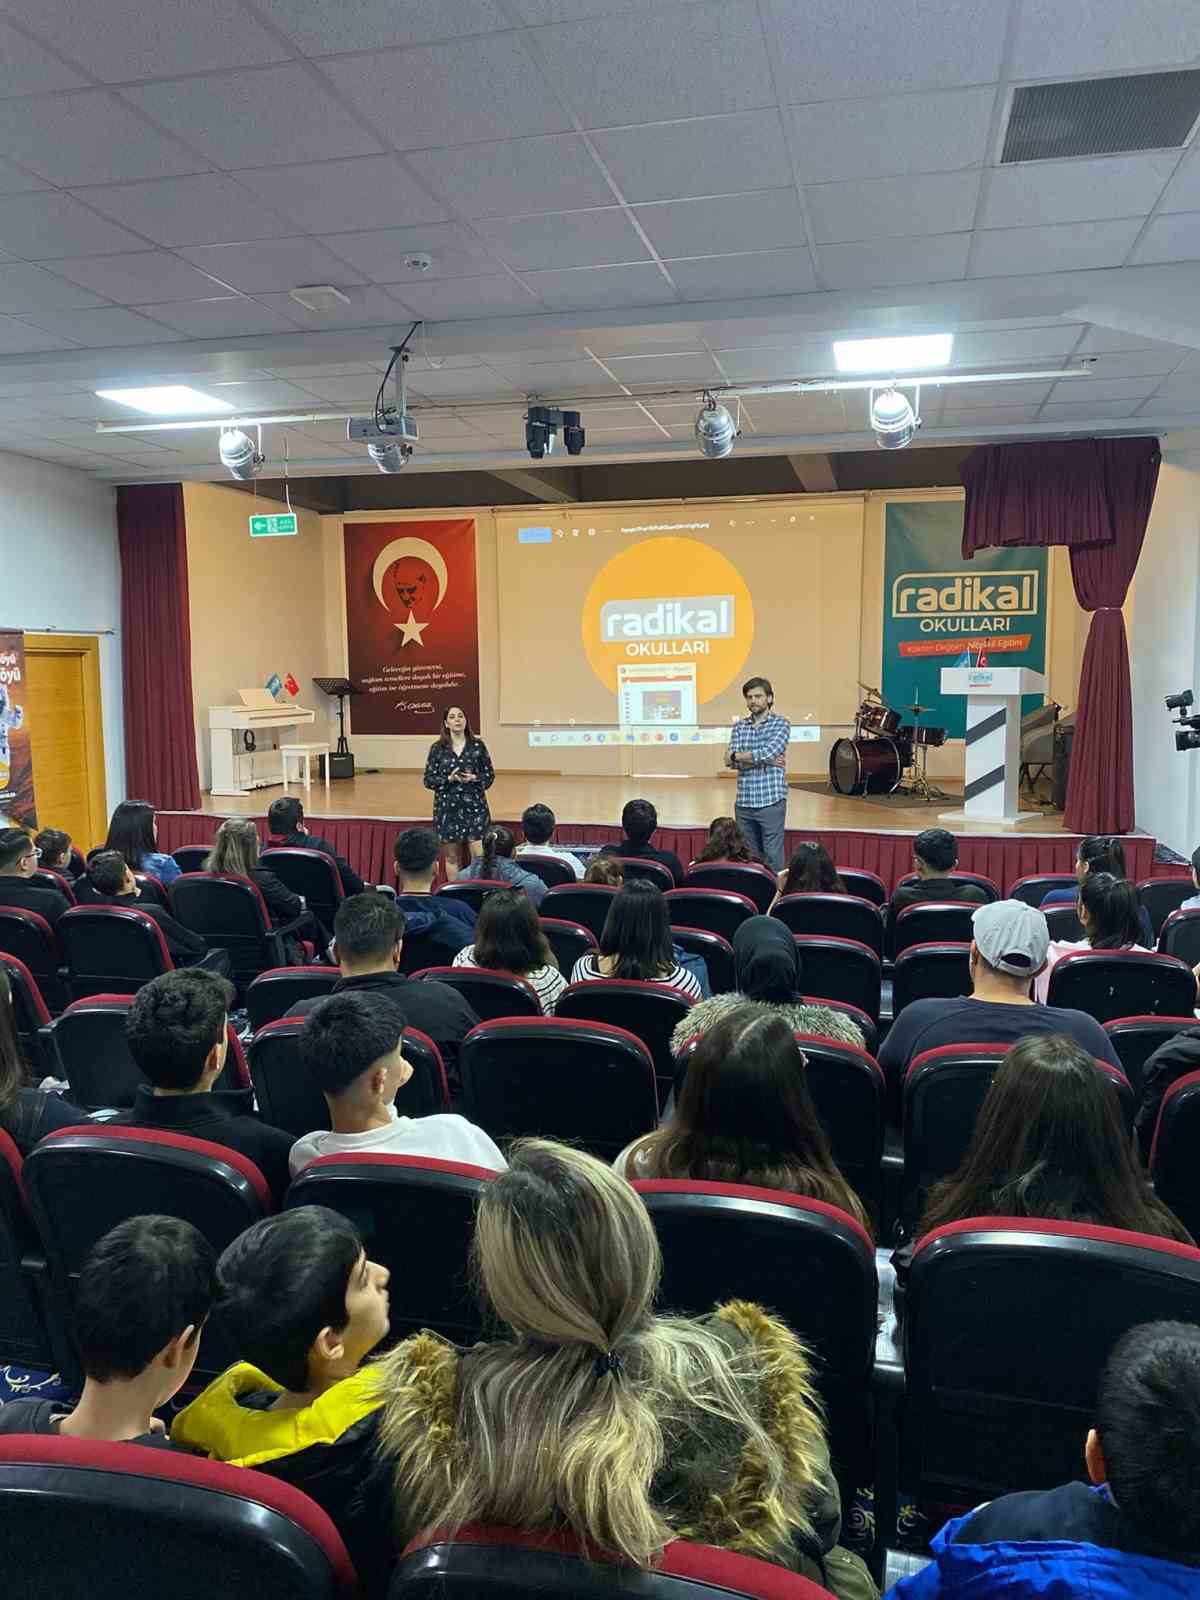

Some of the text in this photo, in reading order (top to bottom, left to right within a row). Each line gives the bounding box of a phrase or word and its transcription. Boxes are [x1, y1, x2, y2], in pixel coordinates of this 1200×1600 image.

[900, 576, 1031, 612] radikal
[607, 600, 729, 637] radikal
[919, 617, 1010, 632] OKULLARI
[625, 640, 710, 656] OKULLARI
[0, 652, 16, 667] öyü
[0, 667, 21, 685] öyü
